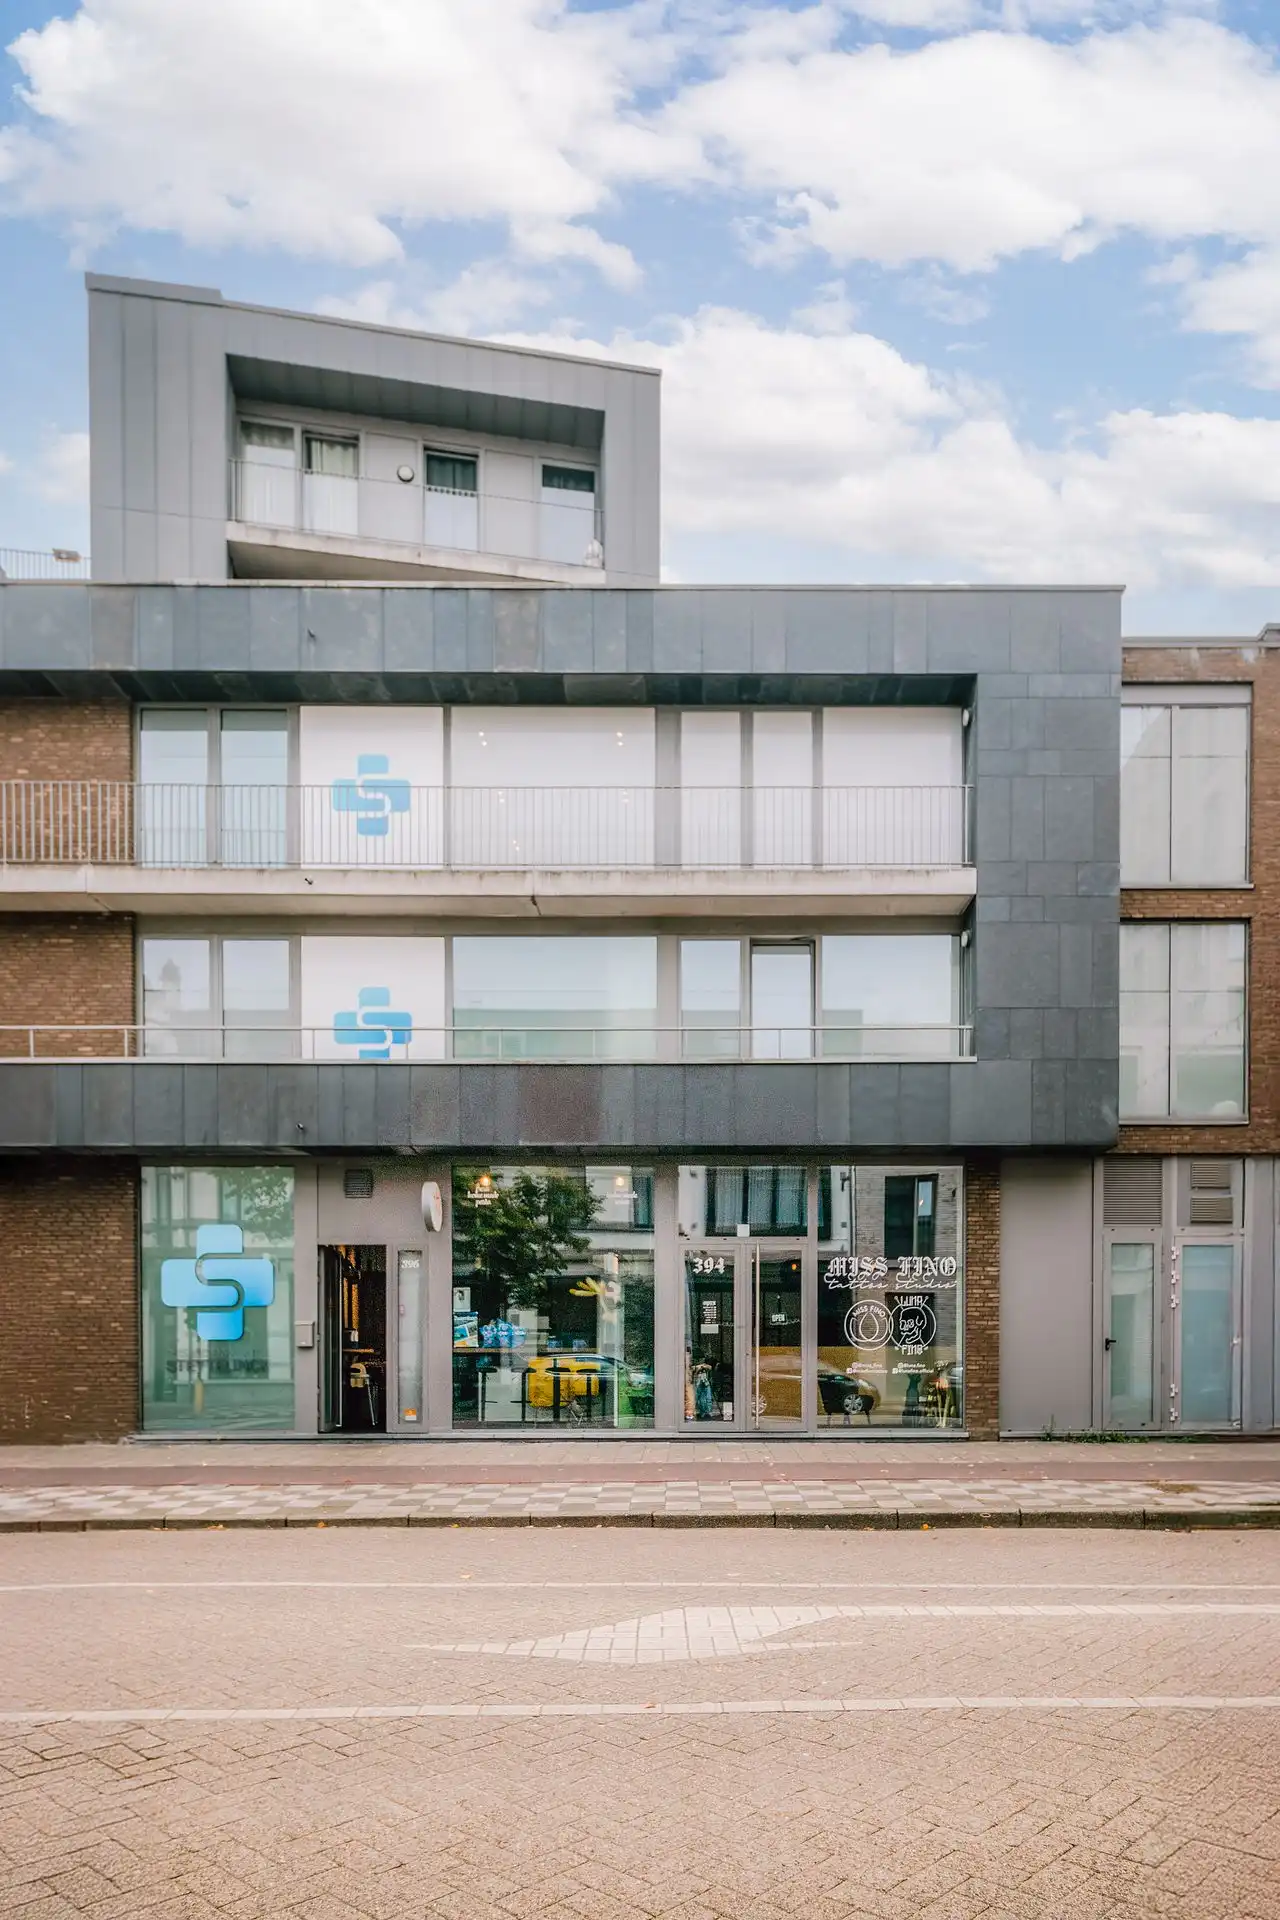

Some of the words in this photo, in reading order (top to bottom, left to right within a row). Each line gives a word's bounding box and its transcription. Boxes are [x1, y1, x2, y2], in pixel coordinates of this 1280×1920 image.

[693, 1257, 725, 1274] 394
[824, 1256, 888, 1281] MISS
[896, 1256, 957, 1282] FINO
[852, 1306, 869, 1318] MISS
[869, 1305, 887, 1318] FINO
